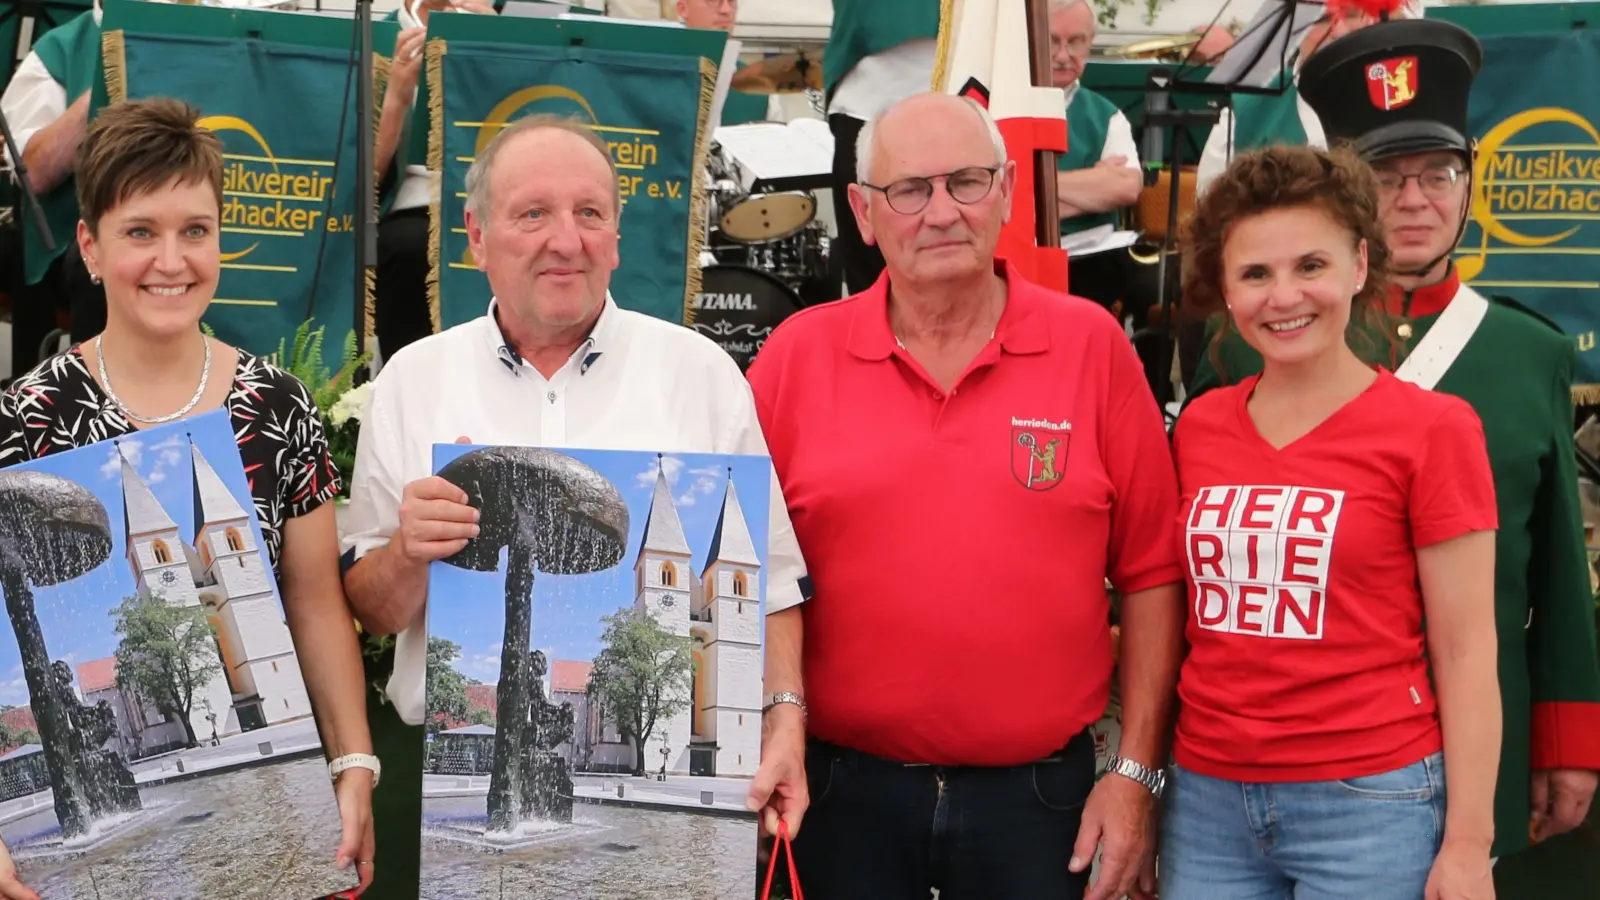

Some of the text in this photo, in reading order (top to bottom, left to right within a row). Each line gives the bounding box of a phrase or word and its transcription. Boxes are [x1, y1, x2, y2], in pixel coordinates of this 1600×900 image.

[647, 181, 682, 198] e.V.
[1190, 488, 1336, 534] HER
[1190, 534, 1324, 585] RIE
[1199, 582, 1321, 635] DEN
